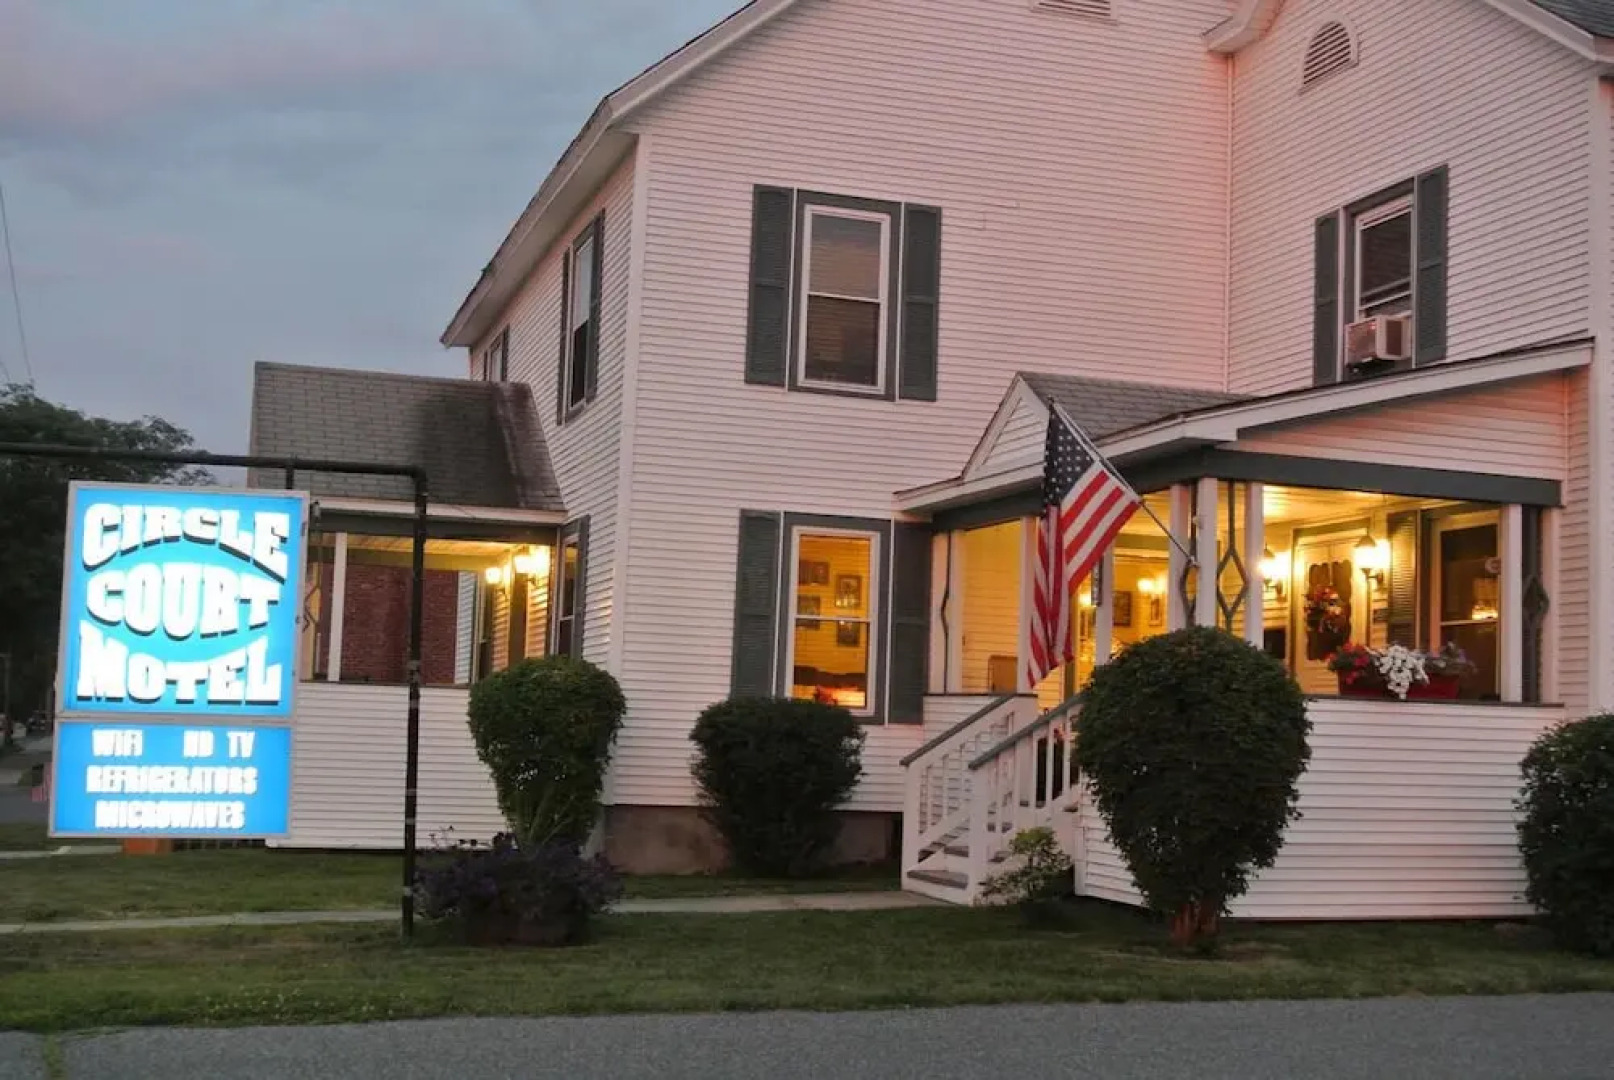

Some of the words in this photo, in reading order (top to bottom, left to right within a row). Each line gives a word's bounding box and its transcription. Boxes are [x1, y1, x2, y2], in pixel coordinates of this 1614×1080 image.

[82, 503, 289, 584] CIRCLE
[86, 562, 280, 641] COURT
[77, 620, 282, 704] MOTEL
[226, 731, 255, 758] TV
[86, 764, 258, 794] REFRIGERATORS
[95, 800, 246, 829] MICROWAVES
